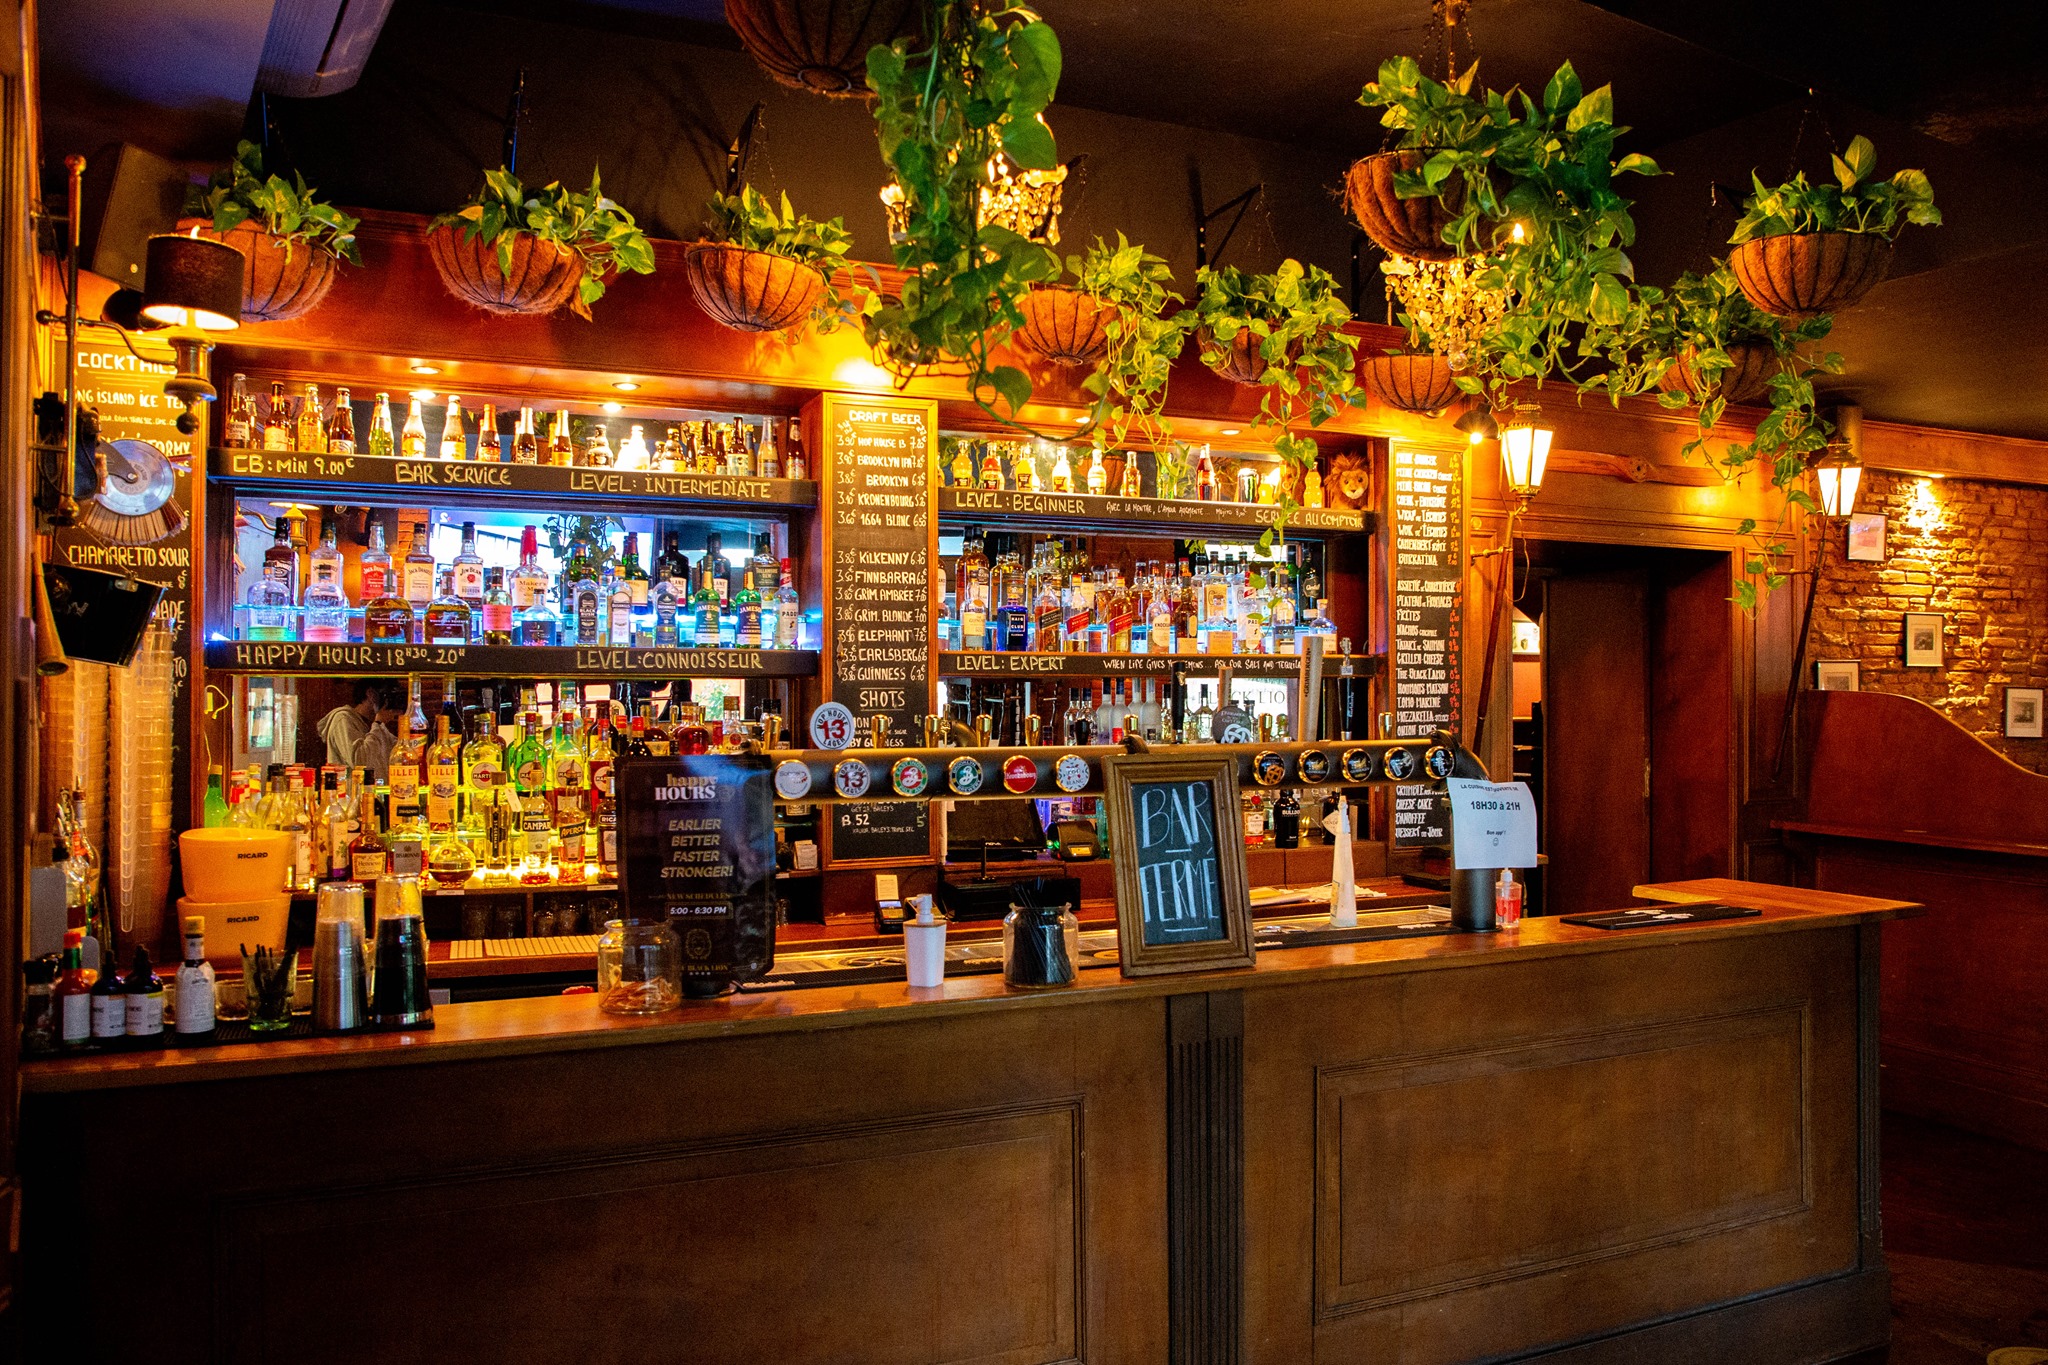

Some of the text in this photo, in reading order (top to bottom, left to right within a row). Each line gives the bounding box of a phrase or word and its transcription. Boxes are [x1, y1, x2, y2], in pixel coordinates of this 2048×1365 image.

[849, 410, 921, 424] DRAFT BEER
[858, 437, 872, 447] HOP
[874, 438, 896, 448] HOUSE
[857, 455, 899, 467] BROOKLYN
[395, 463, 511, 486] BAR SERVICE
[866, 474, 908, 486] BROOKLYN
[571, 473, 771, 498] LEVEL: INTERMEDIATE
[858, 492, 914, 507] KRONENBOURG
[955, 491, 1085, 513] LEVEL: BEGINNER
[860, 513, 881, 525] 1664
[886, 514, 910, 526] BLANC
[1305, 514, 1318, 525] AU
[159, 547, 190, 567] SOUR
[860, 551, 910, 565] KILKENNY
[460, 567, 481, 576] JIM BEAM
[855, 569, 915, 584] FINNBARRA
[880, 586, 914, 601] AMBRÉE
[882, 610, 913, 622] BLONDE
[858, 629, 912, 642] ELEPHANT
[236, 645, 309, 665] HAPPY
[859, 649, 917, 662] CARLSBERG
[956, 656, 1066, 671] LEVEL: EXPERT
[1103, 659, 1125, 669] WHEN
[1146, 658, 1165, 670] GIVES
[1245, 659, 1260, 669] SALT
[857, 666, 906, 681] GUINNESS
[860, 691, 905, 708] SHOTS
[827, 710, 848, 727] HOUSE
[821, 719, 846, 740] 13
[823, 736, 846, 747] LAGER
[841, 771, 864, 789] 13
[655, 786, 716, 800] HOURS
[1471, 801, 1520, 810] 18H30 à 21H
[1142, 781, 1213, 849] BAR
[561, 824, 584, 836] APEROL
[669, 818, 721, 831] EARLIER
[671, 835, 720, 847] BETTER
[673, 850, 719, 862] FASTER
[661, 865, 734, 878] STRONGER!
[1138, 847, 1220, 923] FERMÉ
[670, 906, 727, 915] 5:00 6:30 PM
[227, 915, 259, 923] RICARD
